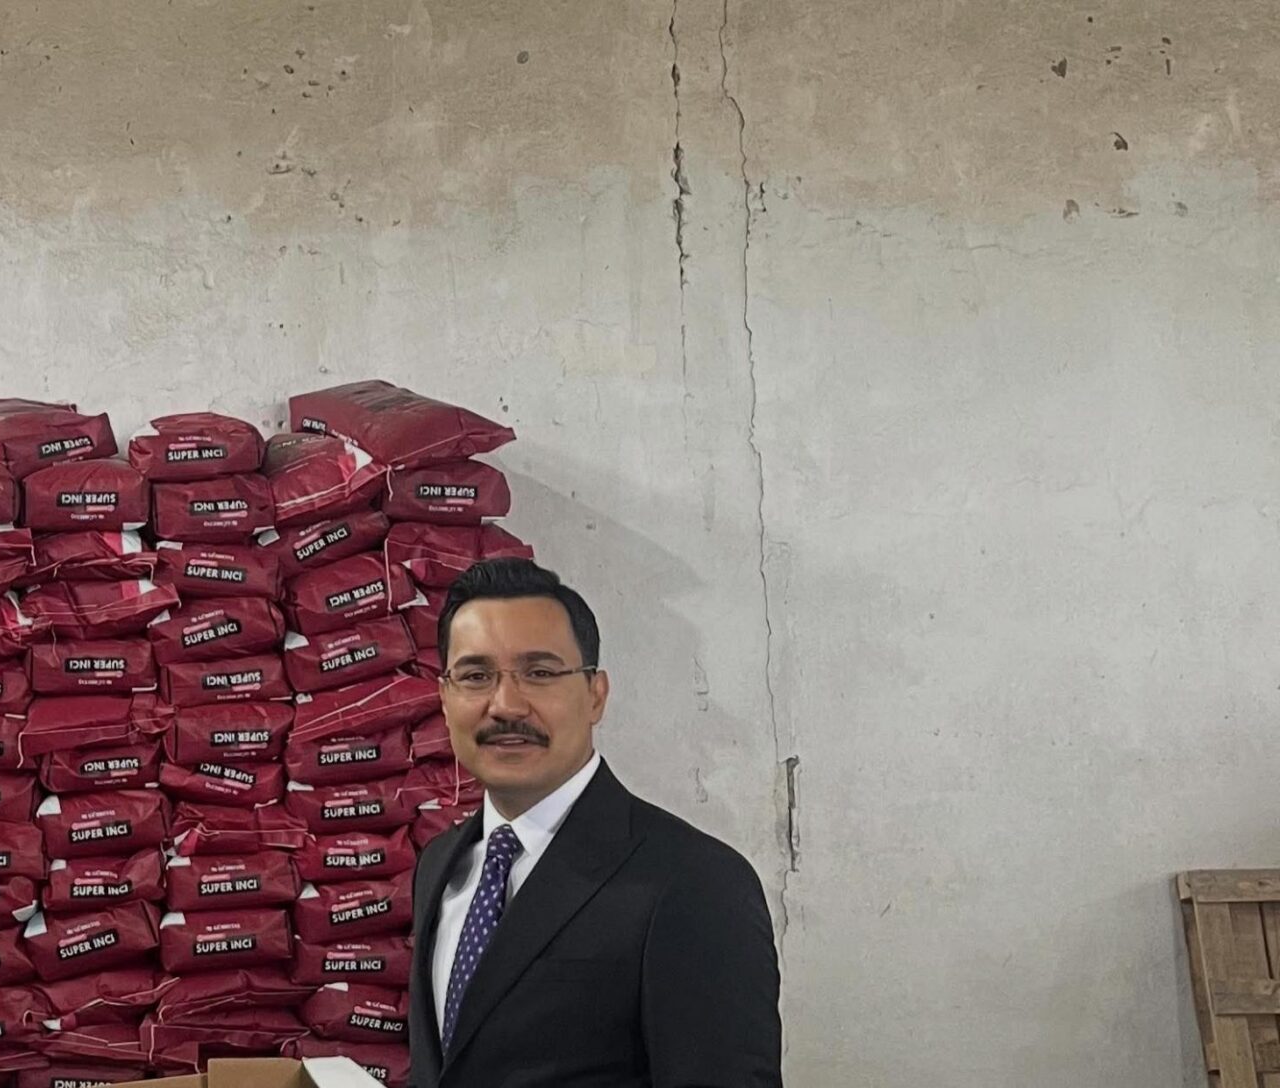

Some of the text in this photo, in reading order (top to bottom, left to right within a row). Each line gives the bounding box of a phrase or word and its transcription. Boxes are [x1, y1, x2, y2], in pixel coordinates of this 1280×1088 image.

[167, 448, 223, 461] SUPER INCI
[61, 493, 116, 504] SUPER INCI
[419, 485, 475, 497] SUPER INCI
[216, 500, 248, 510] SUPER
[296, 538, 326, 559] SUPER
[186, 565, 243, 581] SUPER INCI
[328, 581, 385, 607] SUPER INCI
[183, 622, 238, 645] SUPER INCI
[68, 658, 125, 669] SUPER INCI
[321, 646, 376, 671] SUPER INCI
[205, 671, 261, 686] SUPER INCI
[213, 730, 269, 743] SUPER INCI
[320, 748, 377, 764] SUPER INCI
[83, 758, 139, 771] SUPER INCI
[223, 767, 254, 783] SUPER
[323, 803, 380, 818] SUPER INCI
[71, 823, 128, 841] SUPER INCI
[326, 855, 357, 866] SUPER
[72, 885, 105, 896] SUPER
[200, 878, 257, 894] SUPER INCI
[331, 900, 388, 923] SUPER INCI
[59, 933, 115, 958] SUPER INCI
[195, 937, 252, 953] SUPER INCI
[324, 959, 381, 970] SUPER INCI
[349, 1014, 404, 1032] SUPER INCI
